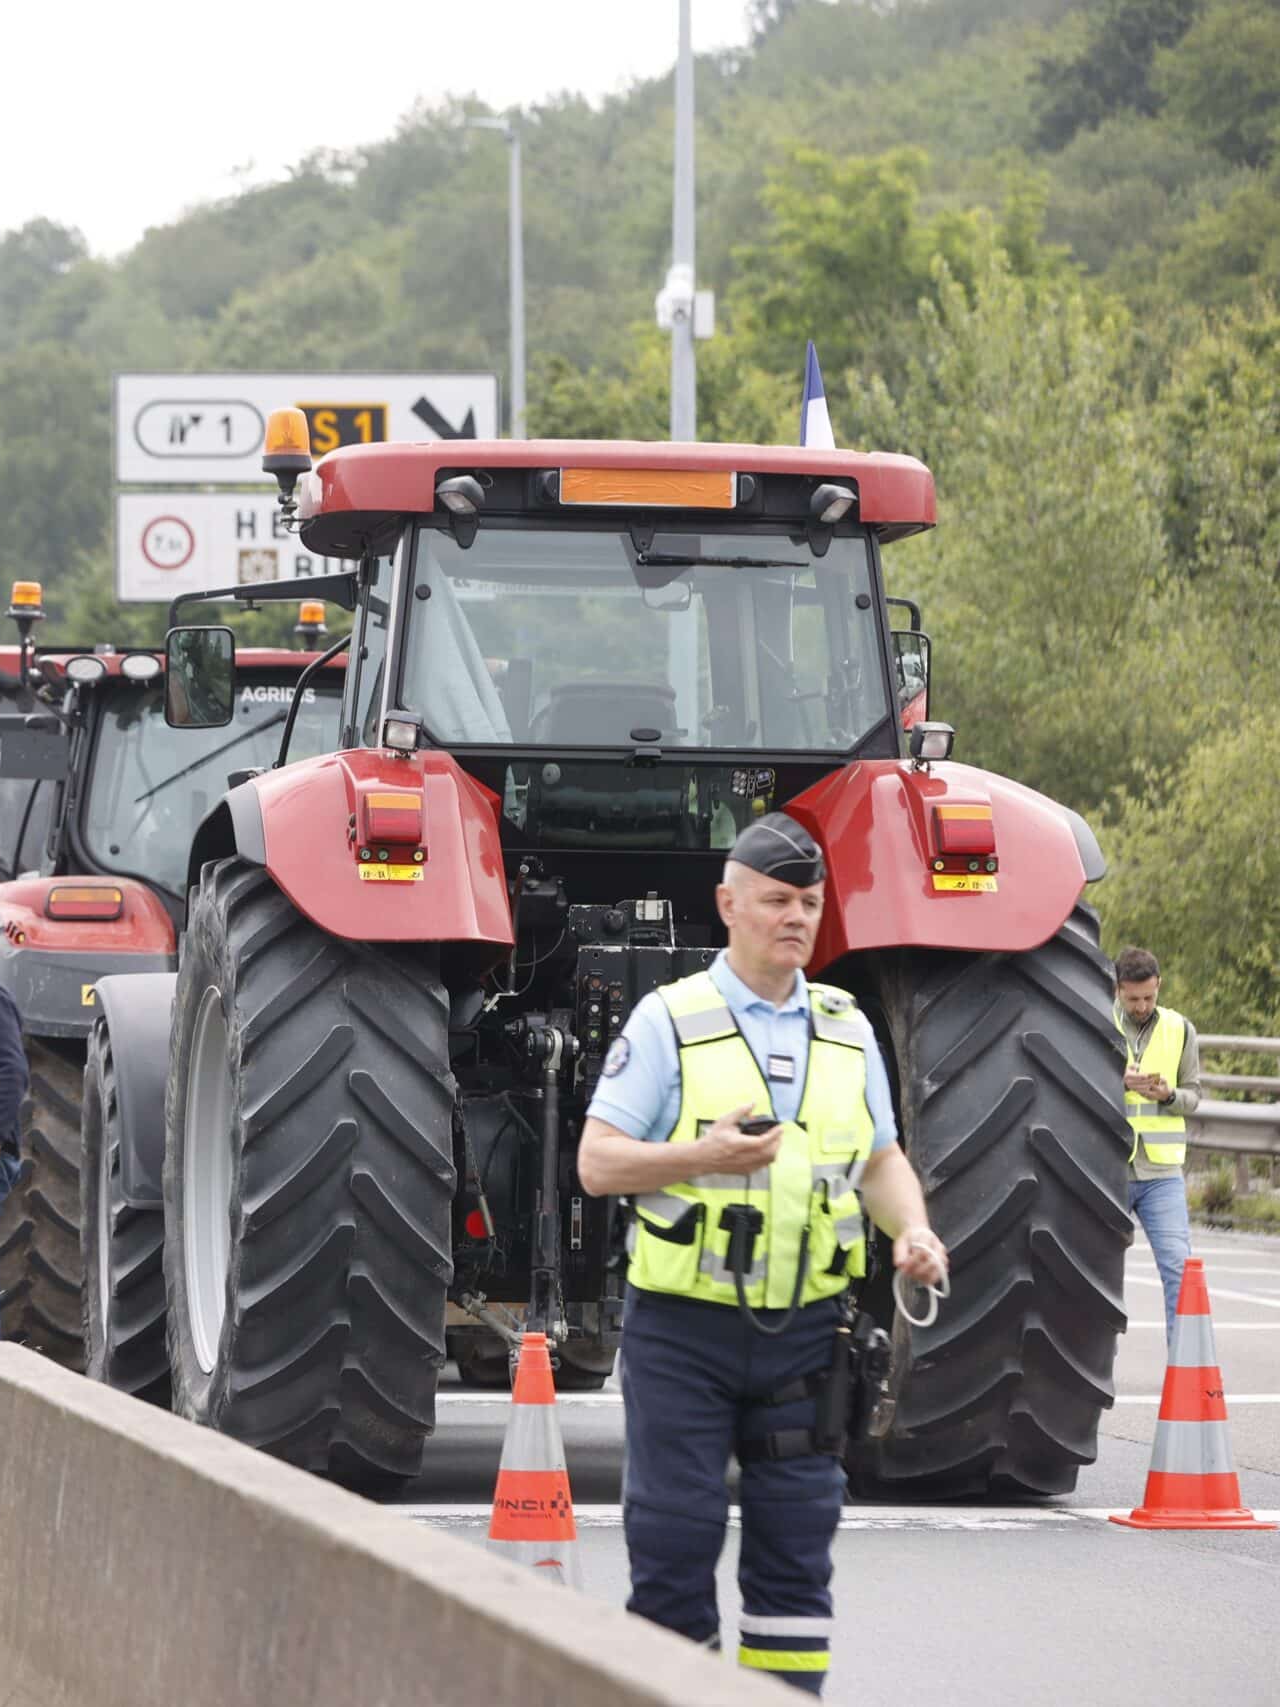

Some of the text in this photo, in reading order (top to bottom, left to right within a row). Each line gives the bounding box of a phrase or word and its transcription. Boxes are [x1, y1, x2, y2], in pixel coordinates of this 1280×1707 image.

[220, 415, 232, 445] 1
[313, 410, 373, 454] S 1
[236, 510, 289, 539] HE
[240, 686, 316, 704] AGRIDS
